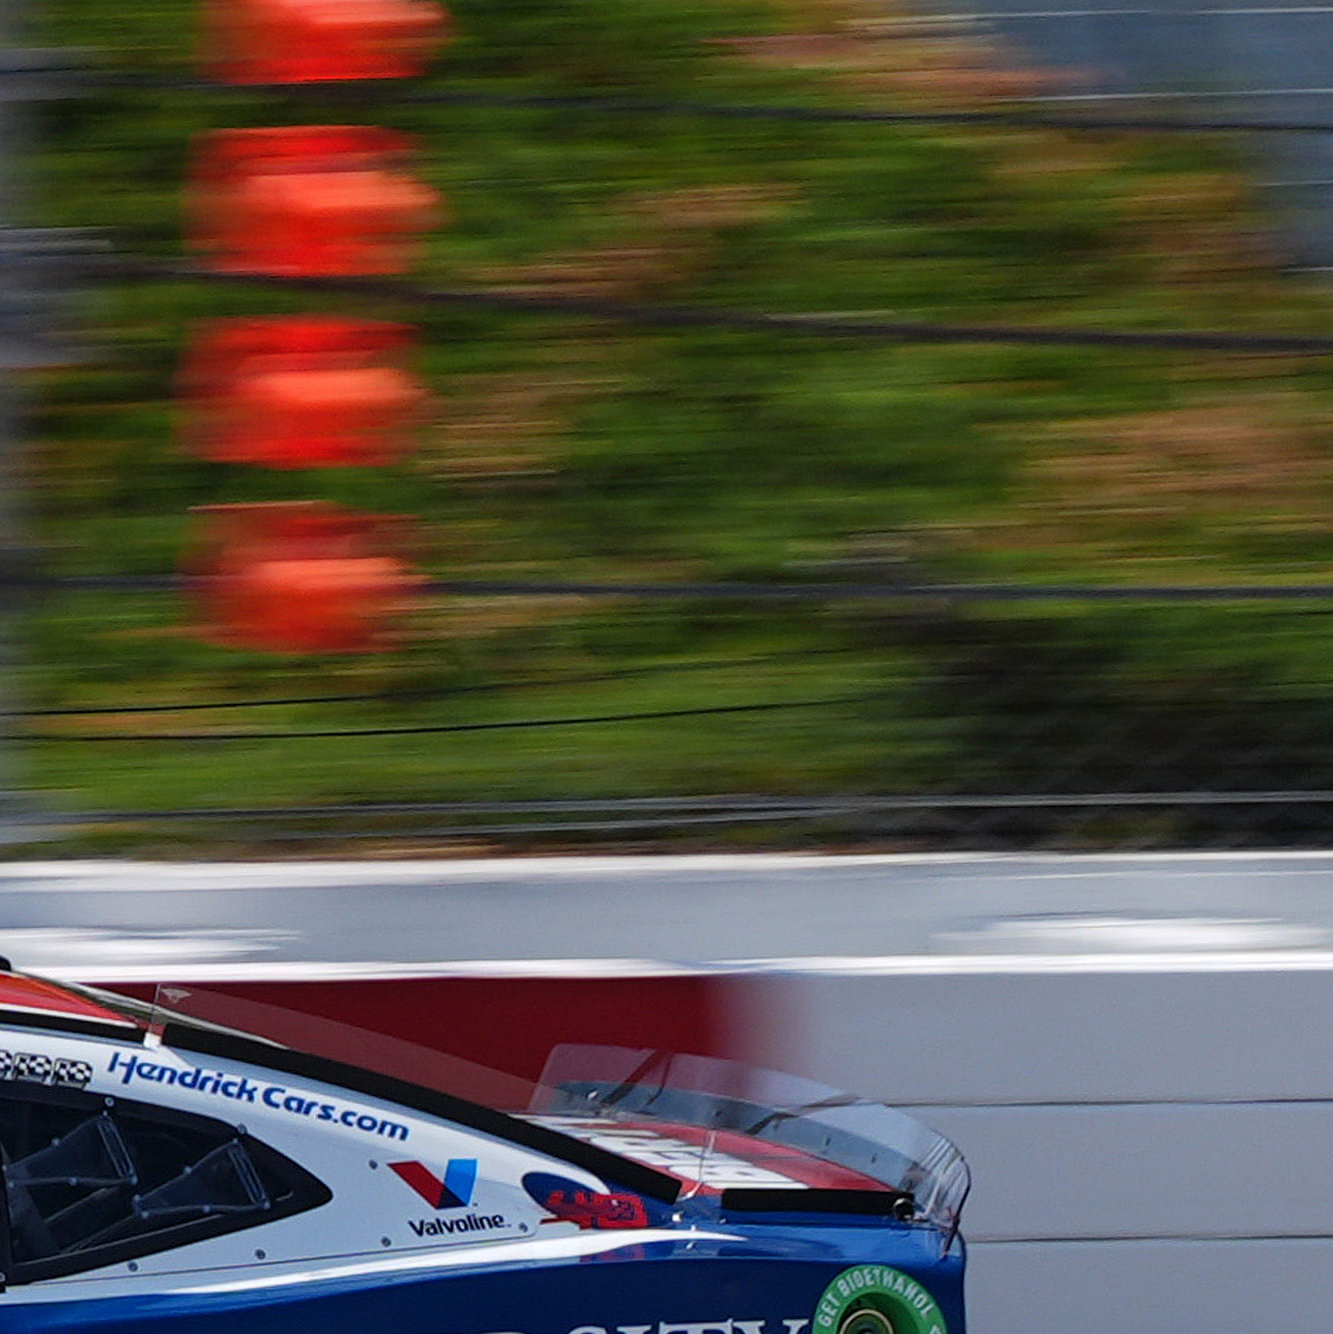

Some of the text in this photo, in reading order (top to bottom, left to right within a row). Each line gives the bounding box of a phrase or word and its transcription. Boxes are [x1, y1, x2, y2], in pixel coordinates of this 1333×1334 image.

[407, 1212, 506, 1237] Valvoline
[817, 1268, 935, 1328] GET BIOETHANOL
